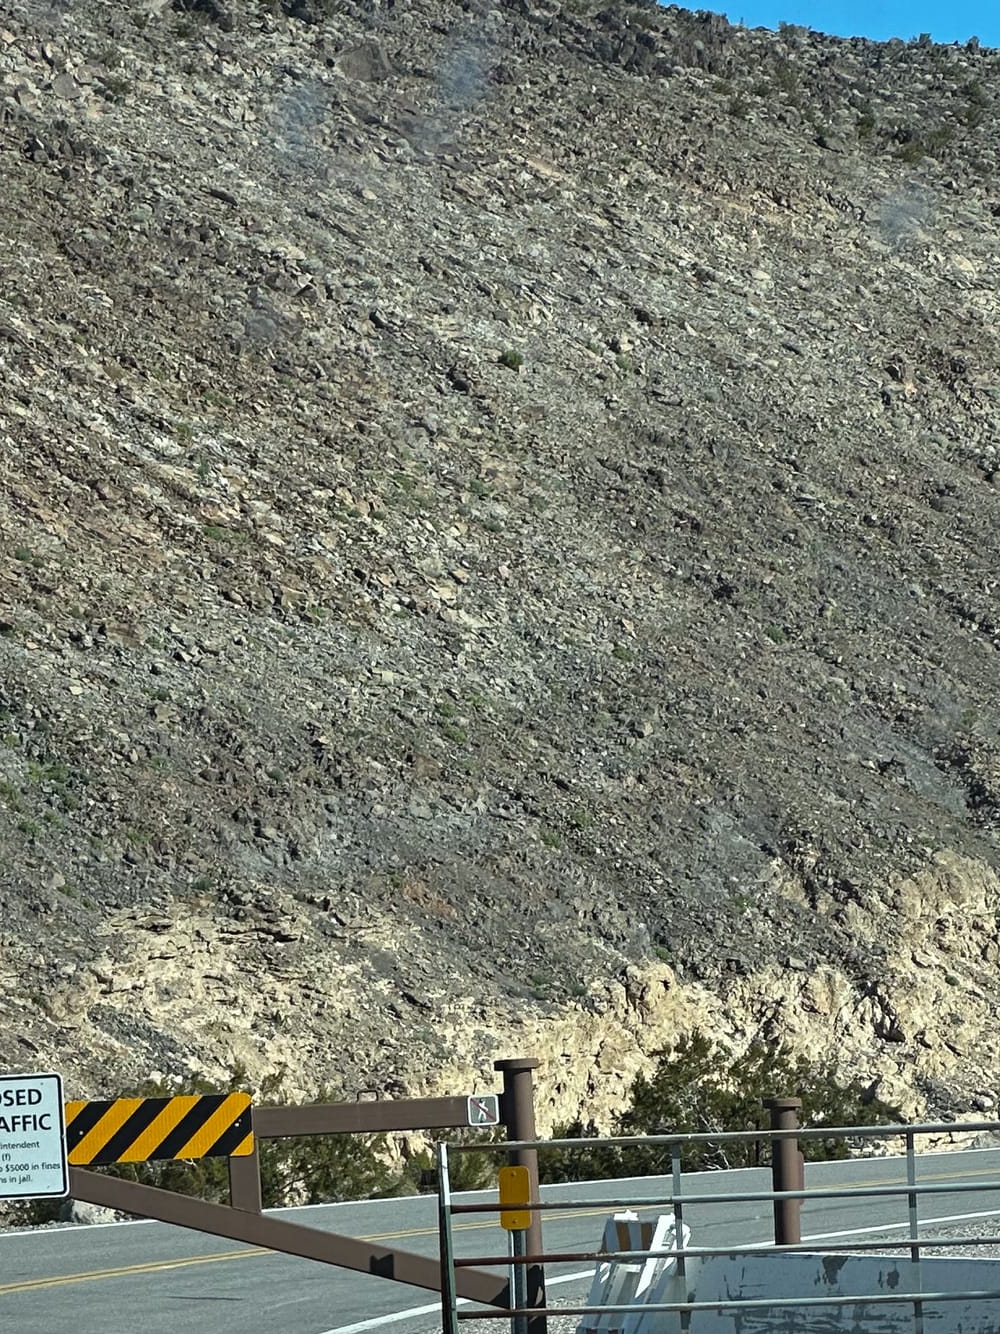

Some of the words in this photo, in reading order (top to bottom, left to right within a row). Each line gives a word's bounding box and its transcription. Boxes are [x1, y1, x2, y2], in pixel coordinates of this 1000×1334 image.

[5, 1162, 30, 1173] $5000
[31, 1163, 40, 1171] in
[41, 1161, 61, 1171] fines
[8, 1174, 17, 1183] in
